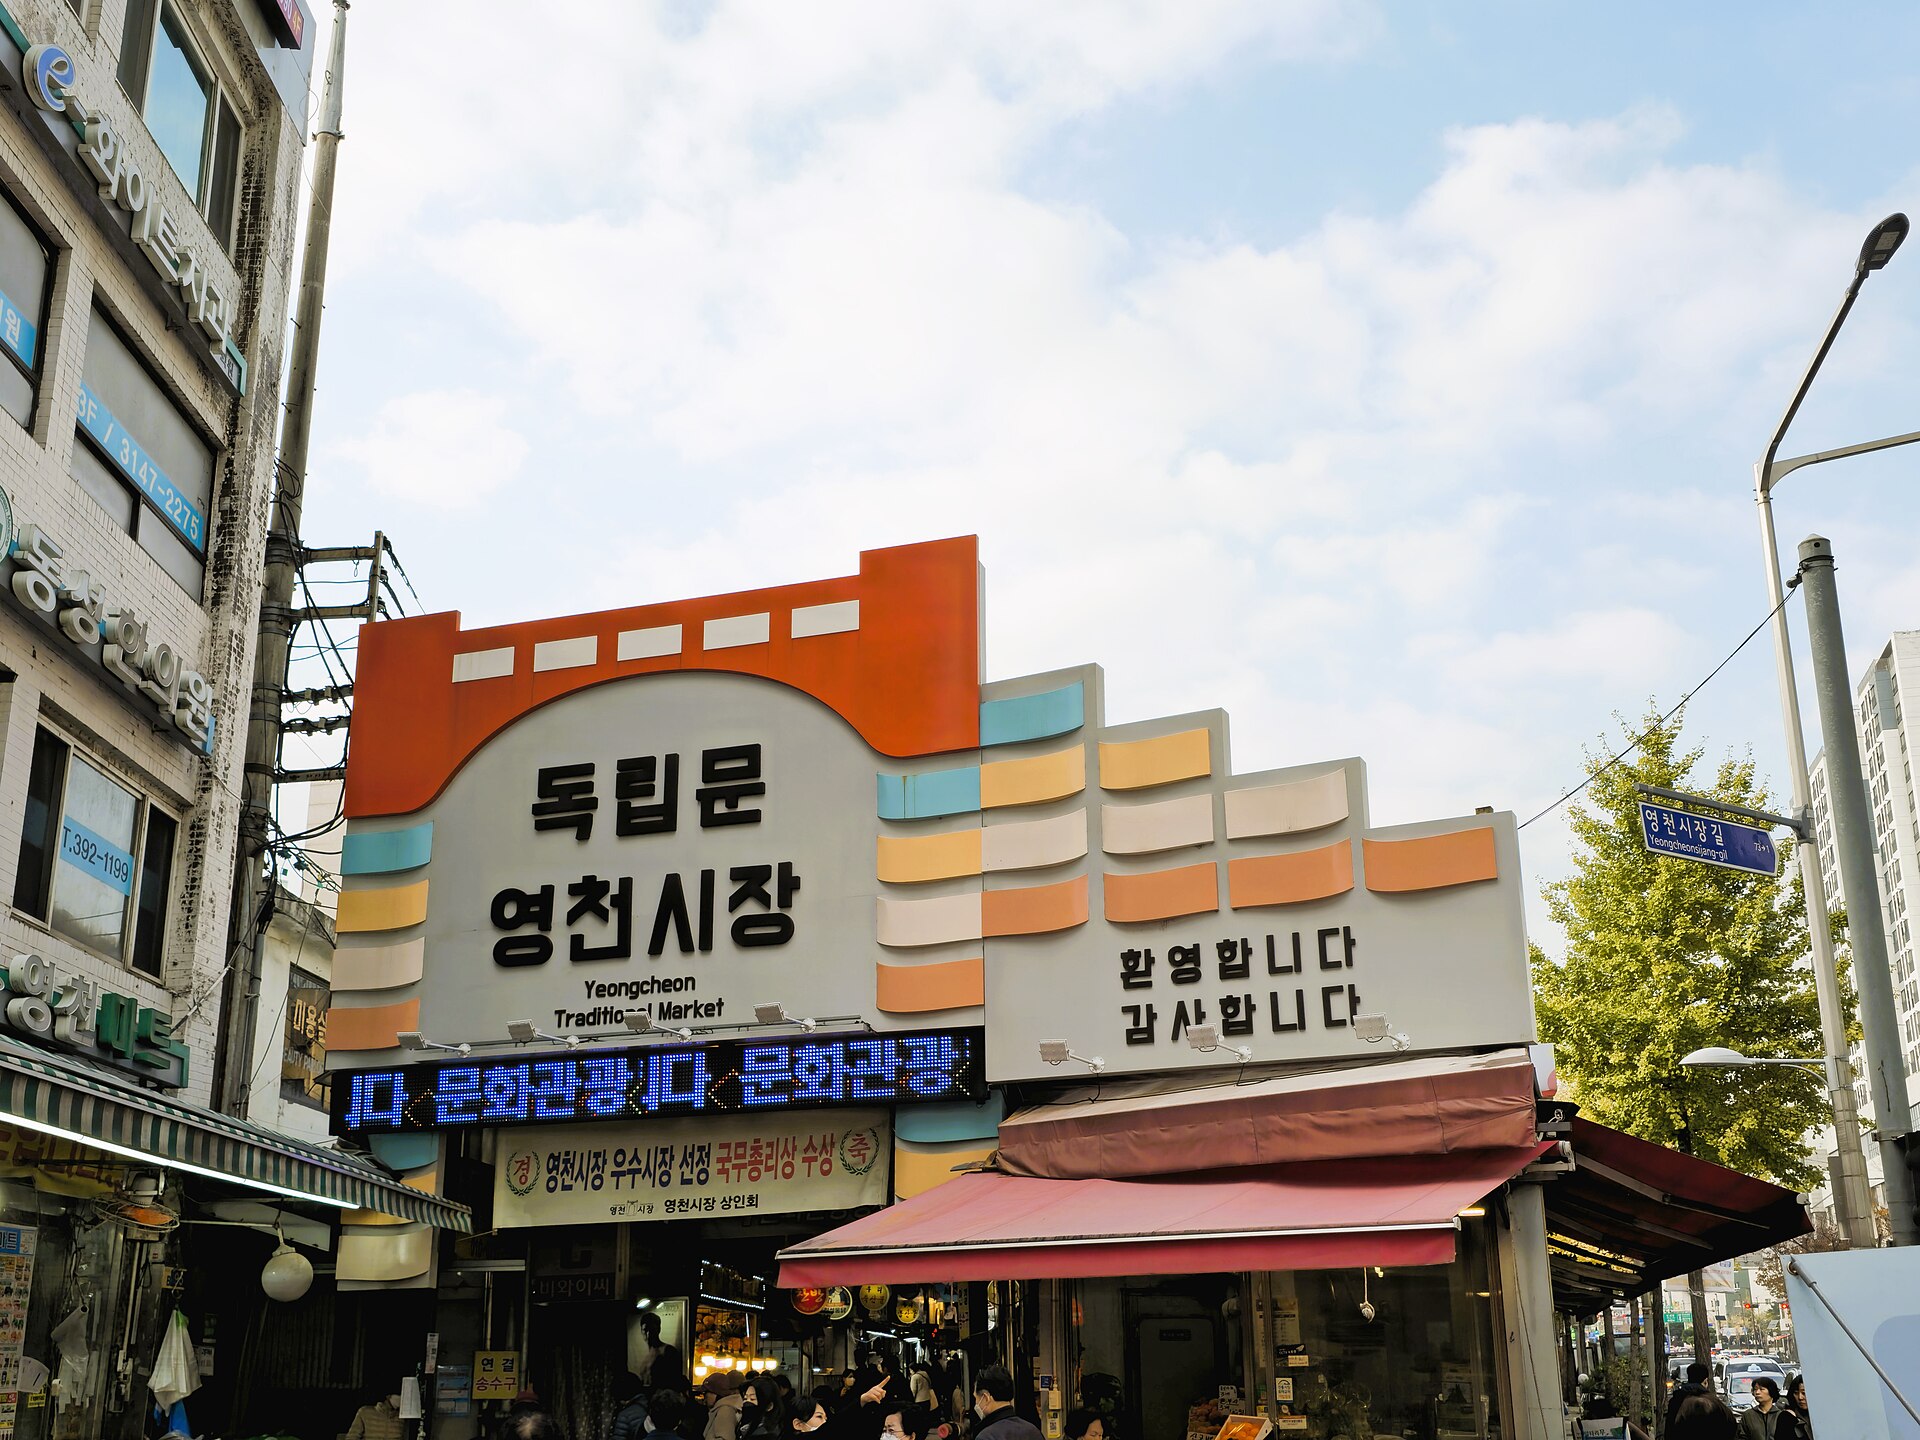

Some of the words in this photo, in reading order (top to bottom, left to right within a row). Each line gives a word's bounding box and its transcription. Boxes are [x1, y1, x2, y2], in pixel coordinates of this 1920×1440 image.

[78, 389, 98, 425] 3F
[120, 438, 200, 540] 3147-2275
[12, 524, 213, 743] 동성한의원
[532, 743, 766, 841] 독립문
[63, 825, 130, 883] T.392-1199
[1645, 809, 1724, 847] 영천시장길
[1649, 833, 1729, 861] Yeongcheonsijang-gil
[490, 861, 801, 967] 영천시장
[1120, 926, 1356, 989] 환영합니다
[7, 953, 173, 1070] 영천마트
[554, 1002, 652, 1028] Traditiol
[659, 998, 724, 1021] Market
[585, 975, 696, 999] Yeongcheon
[1121, 983, 1361, 1045] 감사합니다
[435, 1057, 634, 1124] 문화관광
[739, 1036, 959, 1105] 문화관광
[514, 1155, 531, 1186] 경
[545, 1149, 608, 1194] 영천시장
[610, 1144, 675, 1190] 우수시장
[678, 1142, 712, 1186] 선정
[716, 1135, 798, 1184] 국무총리상
[801, 1132, 836, 1178] 수상
[847, 1133, 872, 1164] 축
[609, 1204, 626, 1216] 영천
[637, 1203, 654, 1215] 시장
[664, 1196, 717, 1214] 영천시장
[720, 1193, 759, 1210] 상인회
[475, 1376, 517, 1391] 송수구
[481, 1356, 515, 1374] 연결
